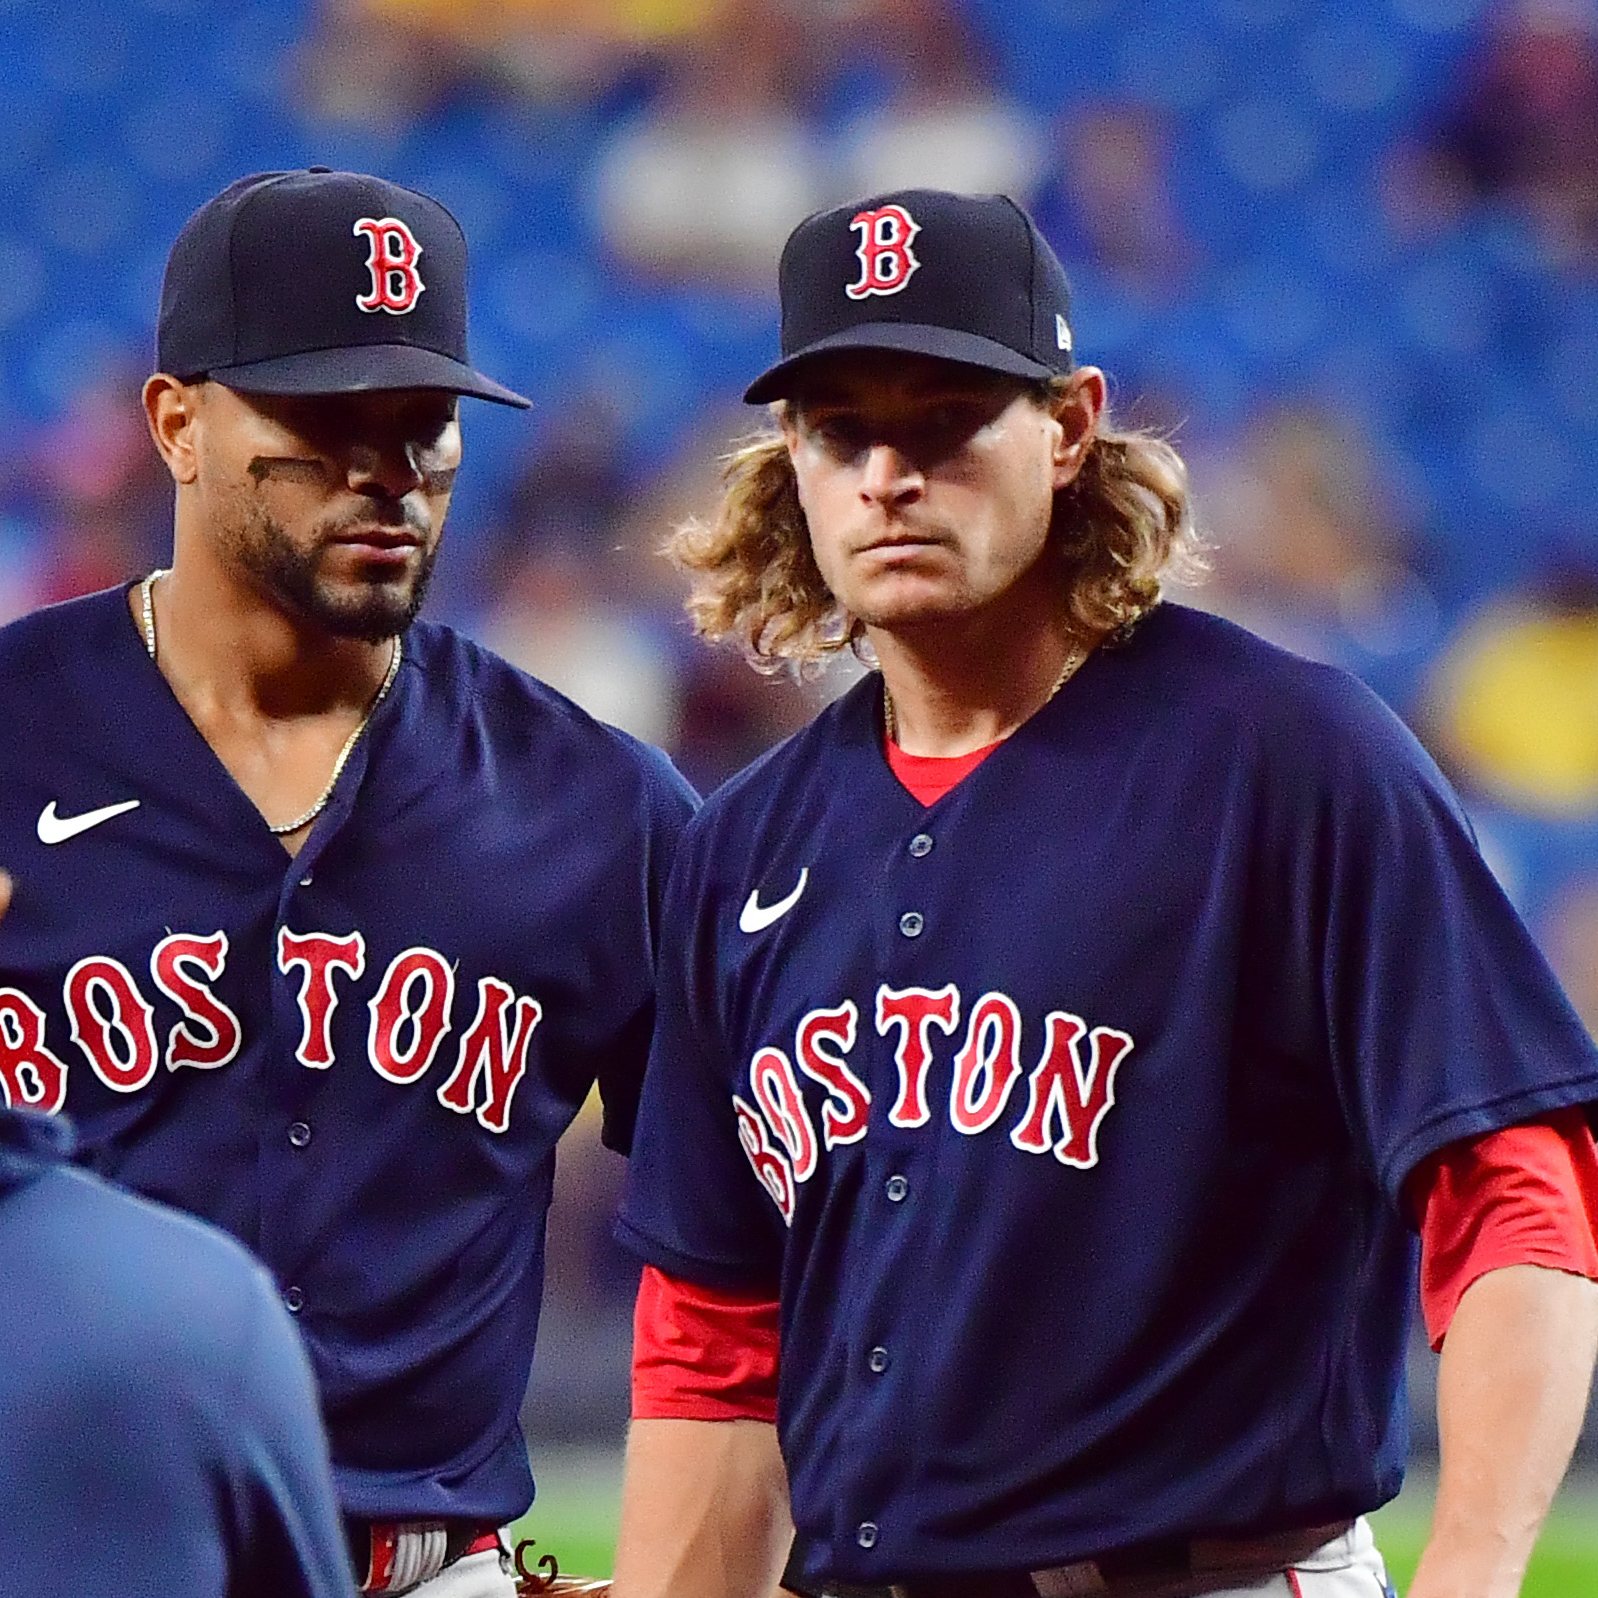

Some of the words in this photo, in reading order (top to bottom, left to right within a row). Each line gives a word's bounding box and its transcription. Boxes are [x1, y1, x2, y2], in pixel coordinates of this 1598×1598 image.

[353, 217, 426, 315] B
[845, 204, 923, 300] B
[732, 982, 1135, 1227] BOSTON
